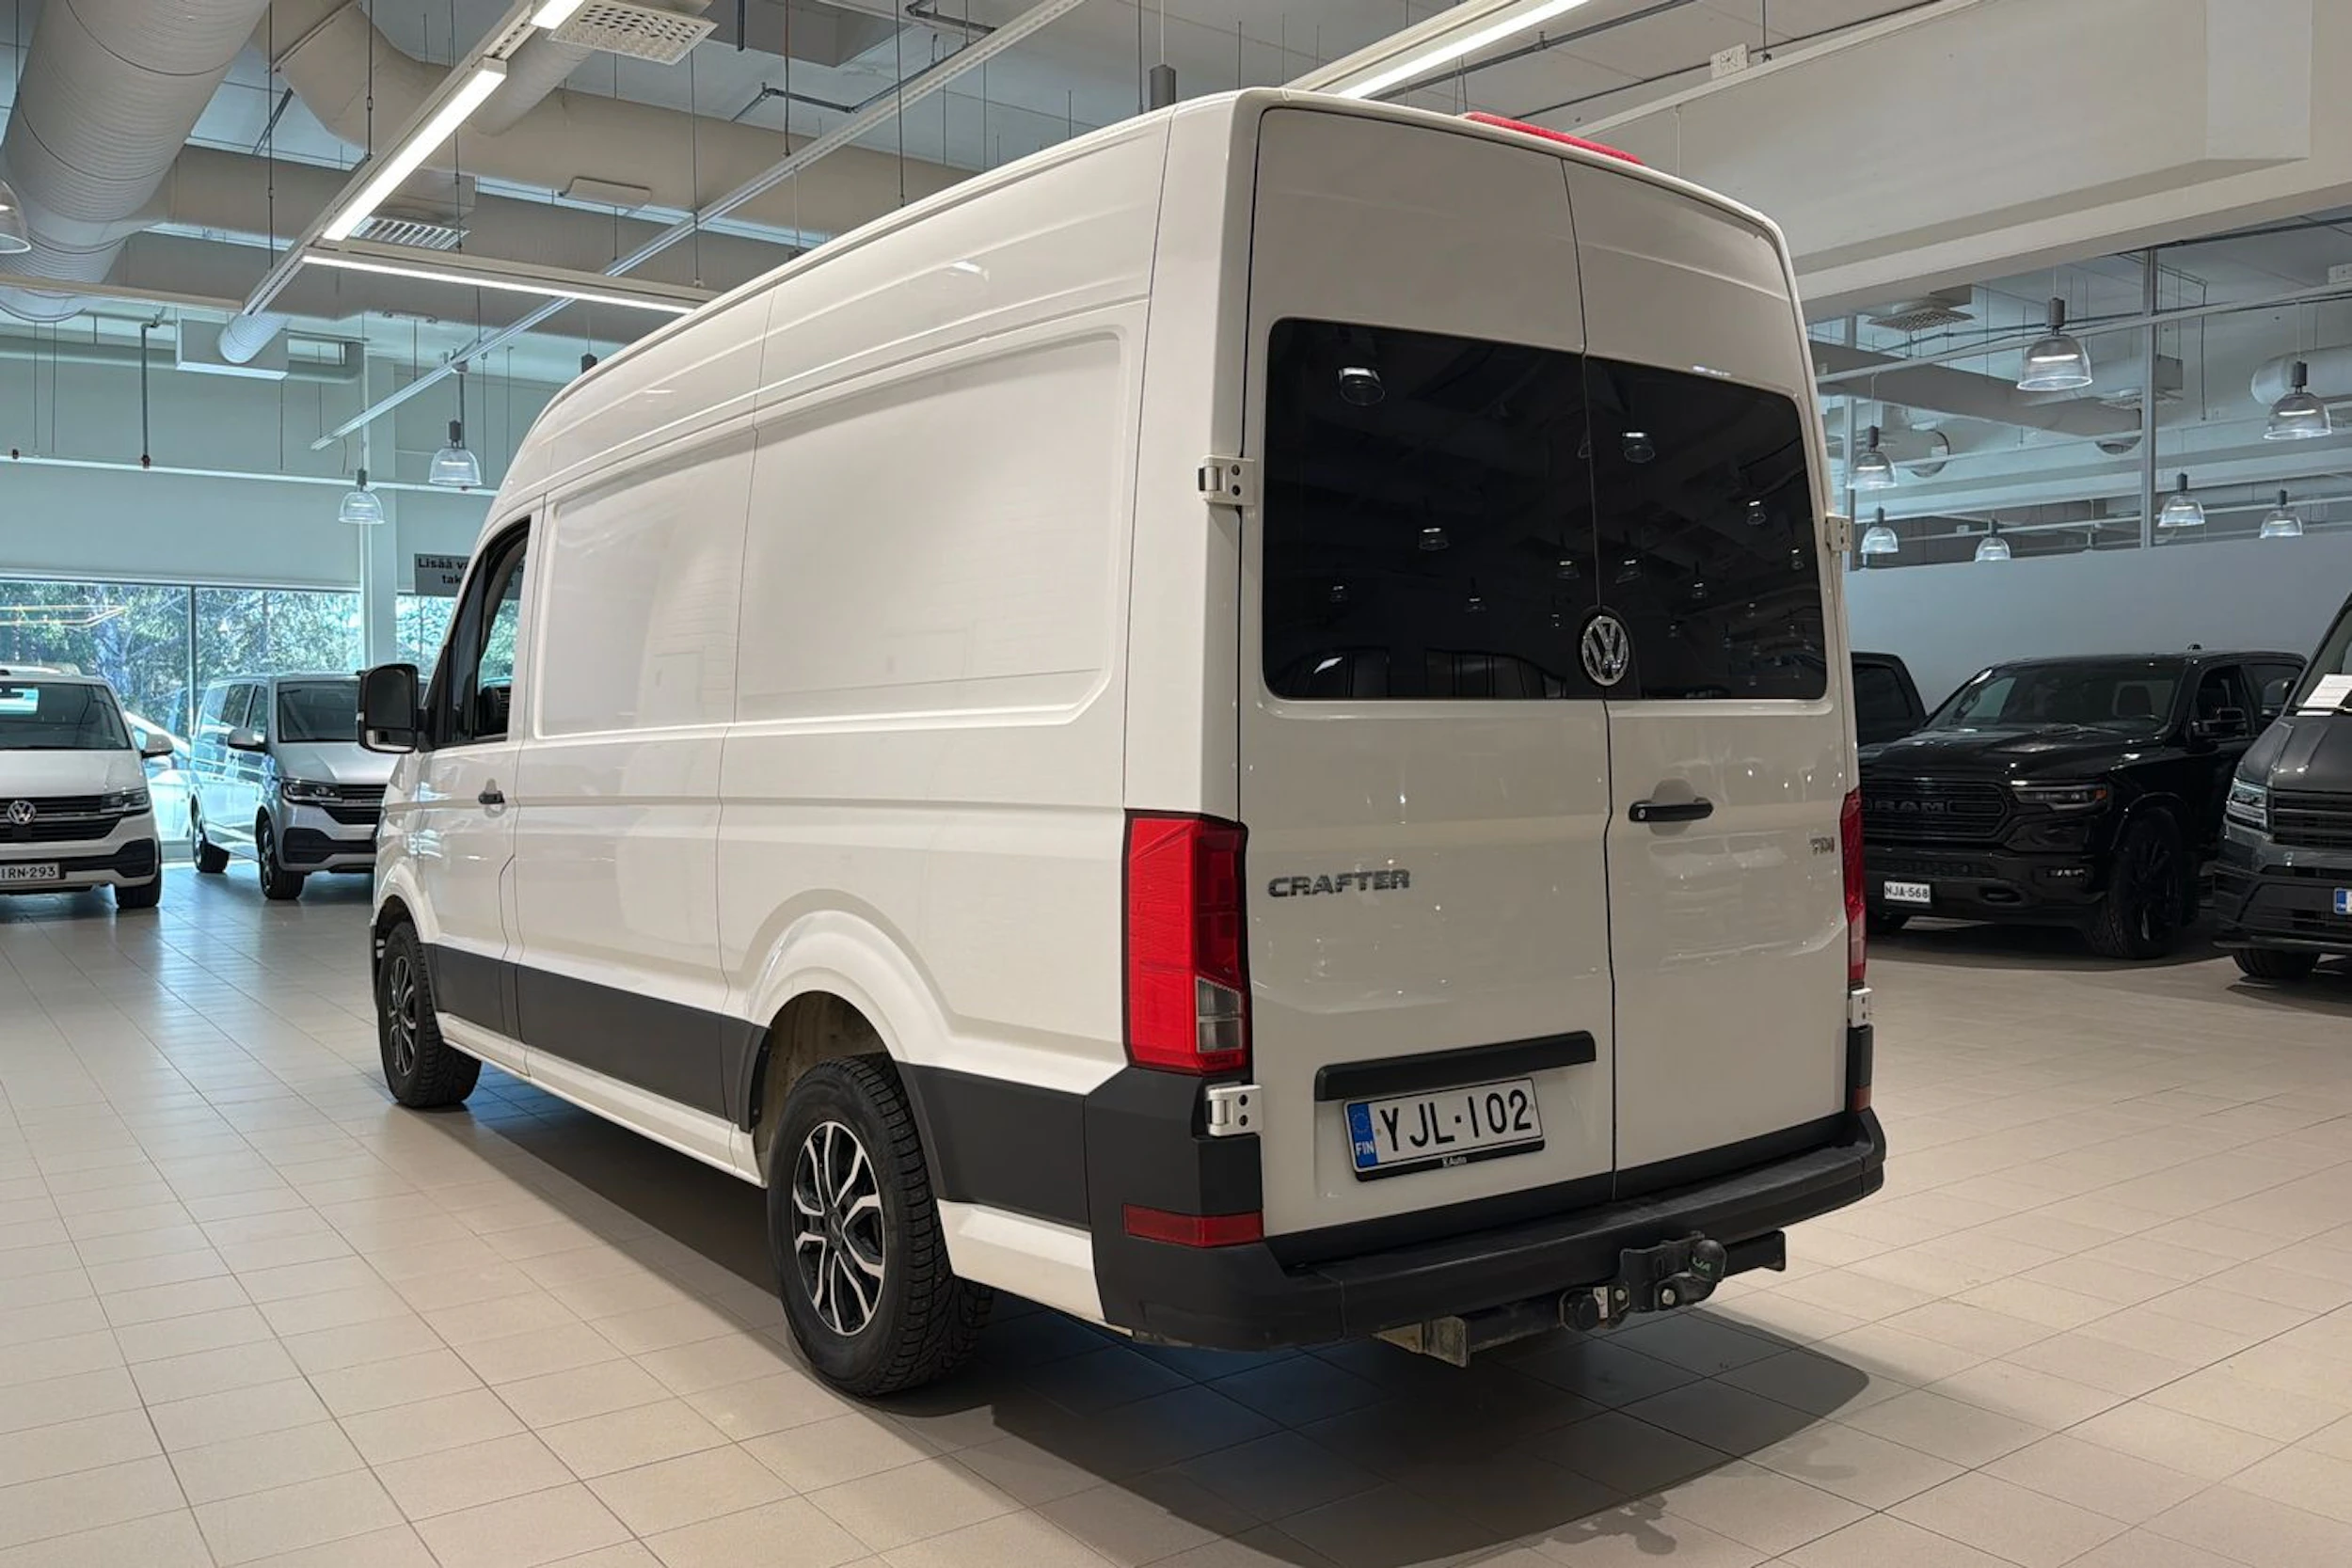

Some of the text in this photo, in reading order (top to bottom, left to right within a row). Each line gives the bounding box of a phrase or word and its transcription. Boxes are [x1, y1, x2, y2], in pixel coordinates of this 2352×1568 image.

[1267, 868, 1410, 897] CRAFTER
[1884, 885, 1929, 899] NJA-568
[1379, 1088, 1532, 1151] YJL-102
[1355, 1141, 1375, 1156] FIN
